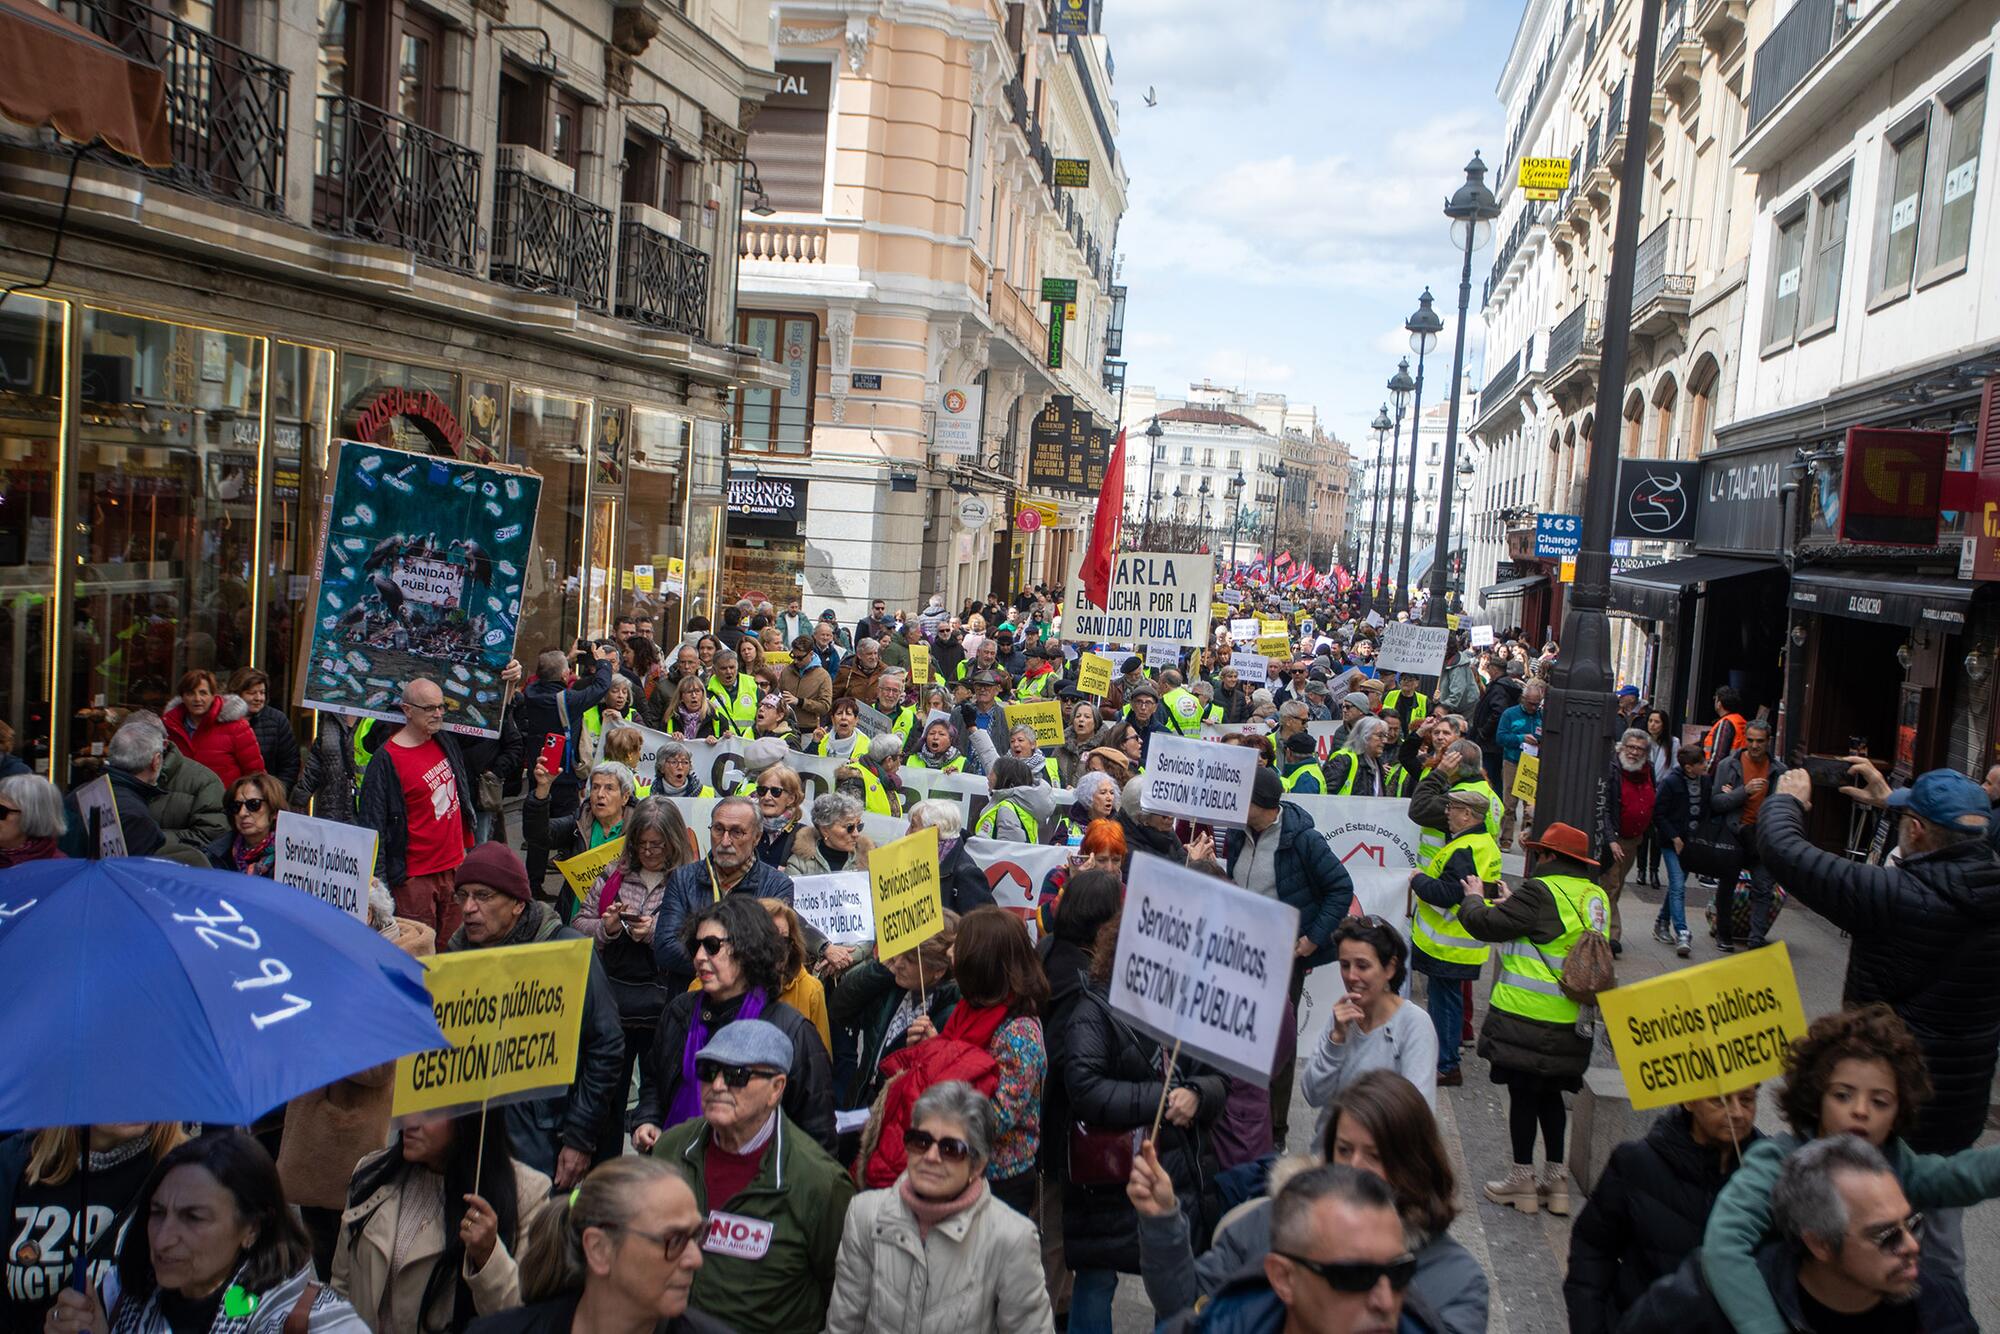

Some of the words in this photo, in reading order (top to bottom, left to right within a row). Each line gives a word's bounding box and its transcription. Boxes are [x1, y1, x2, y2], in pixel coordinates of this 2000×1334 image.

[776, 76, 808, 95] TAL
[1523, 158, 1568, 169] HOSTAL
[1049, 304, 1063, 367] BIARRITZ
[727, 479, 792, 496] RRONES
[1727, 462, 1780, 501] TAURINA
[727, 491, 795, 508] TESANOS
[751, 506, 778, 514] ALICANTE
[1537, 534, 1578, 546] Change
[1538, 544, 1574, 555] Money
[401, 578, 452, 596] PÚBLICA
[403, 565, 454, 581] SANIDAD
[1116, 558, 1177, 587] ARLA
[1109, 591, 1141, 612] UCHA
[1149, 592, 1173, 612] POR
[1180, 592, 1197, 613] LA
[1857, 597, 1882, 615] GAUCHO
[1076, 615, 1133, 637] SANIDAD
[1139, 618, 1193, 640] PUBLICA
[453, 723, 485, 736] RECLAMA
[1157, 752, 1195, 777] Servicios
[1197, 758, 1205, 779] %
[1204, 760, 1242, 787] públicos,
[1151, 780, 1190, 804] GESTIÓN
[1191, 786, 1199, 806] %
[1199, 785, 1238, 811] PÚBLICA.
[285, 836, 318, 866] Servicios
[324, 847, 360, 881] públicos,
[1345, 822, 1377, 832] Estatal
[1376, 827, 1394, 839] por
[1392, 834, 1402, 845] la
[1400, 842, 1418, 869] Defen
[878, 868, 910, 902] Servicios
[909, 857, 933, 894] públicos,
[321, 877, 359, 913] PÚBLICA.
[794, 891, 820, 911] ervicios
[820, 891, 829, 910] %
[830, 889, 862, 912] públicos,
[830, 912, 866, 934] PÚBLICA.
[882, 900, 916, 943] GESTIÓN
[1137, 895, 1191, 953] Servicios
[1192, 916, 1207, 959] %
[1203, 924, 1267, 990] públicos,
[171, 898, 313, 1031] 7291
[434, 987, 498, 1030] ervicios
[499, 979, 566, 1031] públicos,
[1125, 952, 1180, 1010] GESTIÓN
[1177, 973, 1191, 1017] %
[1189, 975, 1257, 1043] PÚBLICA.
[1627, 1003, 1706, 1047] Servicios
[1705, 985, 1782, 1036] públicos,
[412, 1034, 490, 1092] GESTIÓN
[491, 1030, 559, 1079] DIRECTA.
[1639, 1041, 1719, 1092] GESTIÓN
[9, 1205, 114, 1262] 729
[711, 1218, 765, 1243] NO+
